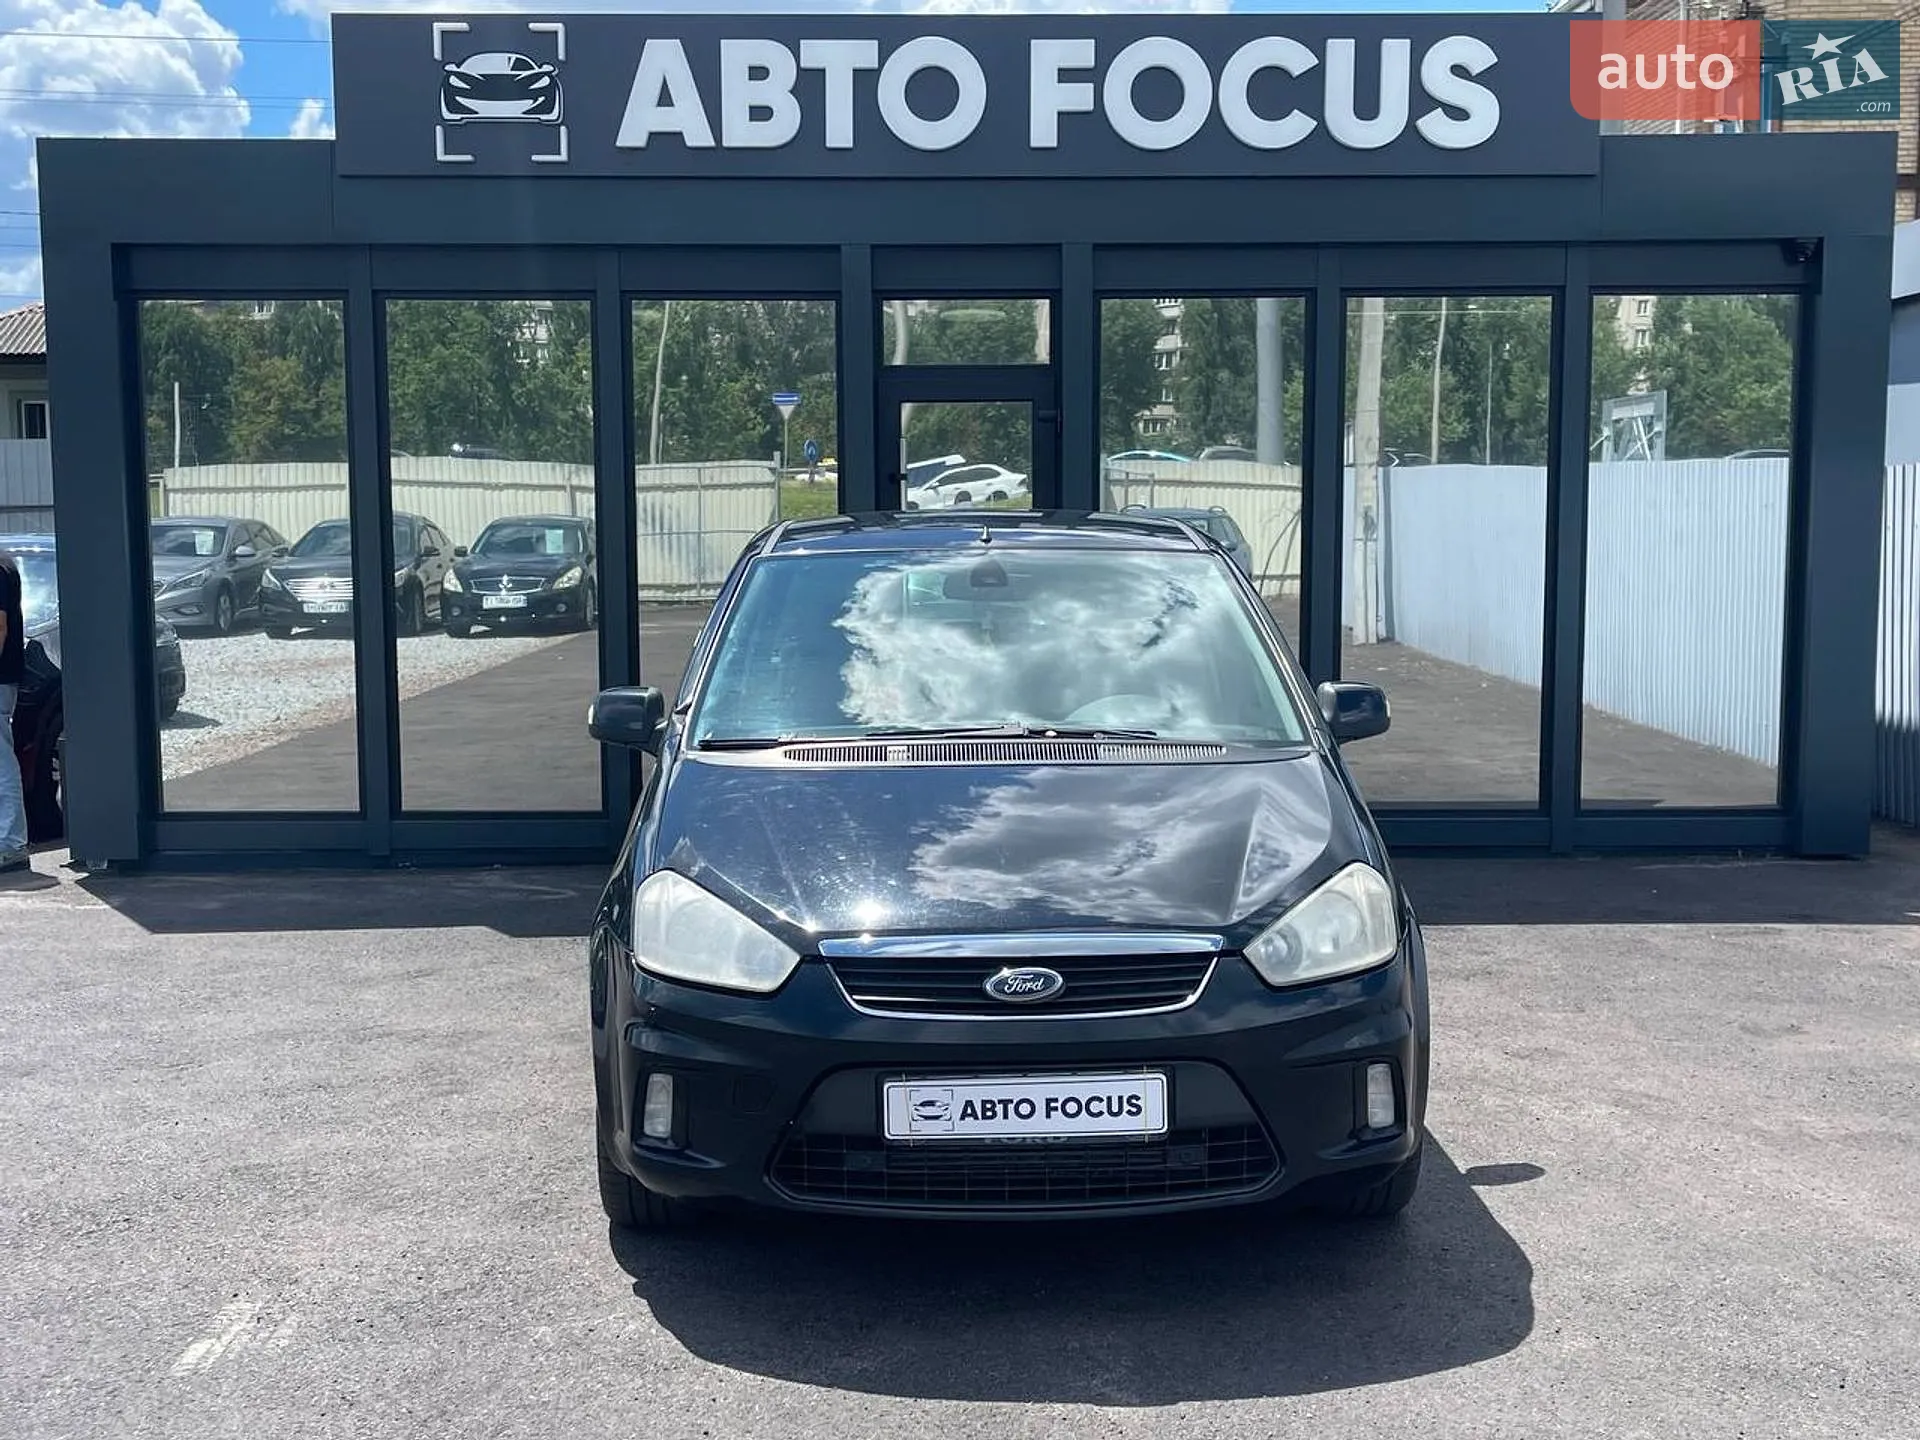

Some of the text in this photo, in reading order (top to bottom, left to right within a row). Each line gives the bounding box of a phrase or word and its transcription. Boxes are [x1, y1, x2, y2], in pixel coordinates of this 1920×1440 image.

[615, 35, 1501, 151] АВТО FOCUS
[1004, 974, 1045, 994] Ford
[959, 1094, 1143, 1121] АВТО FOCUS
